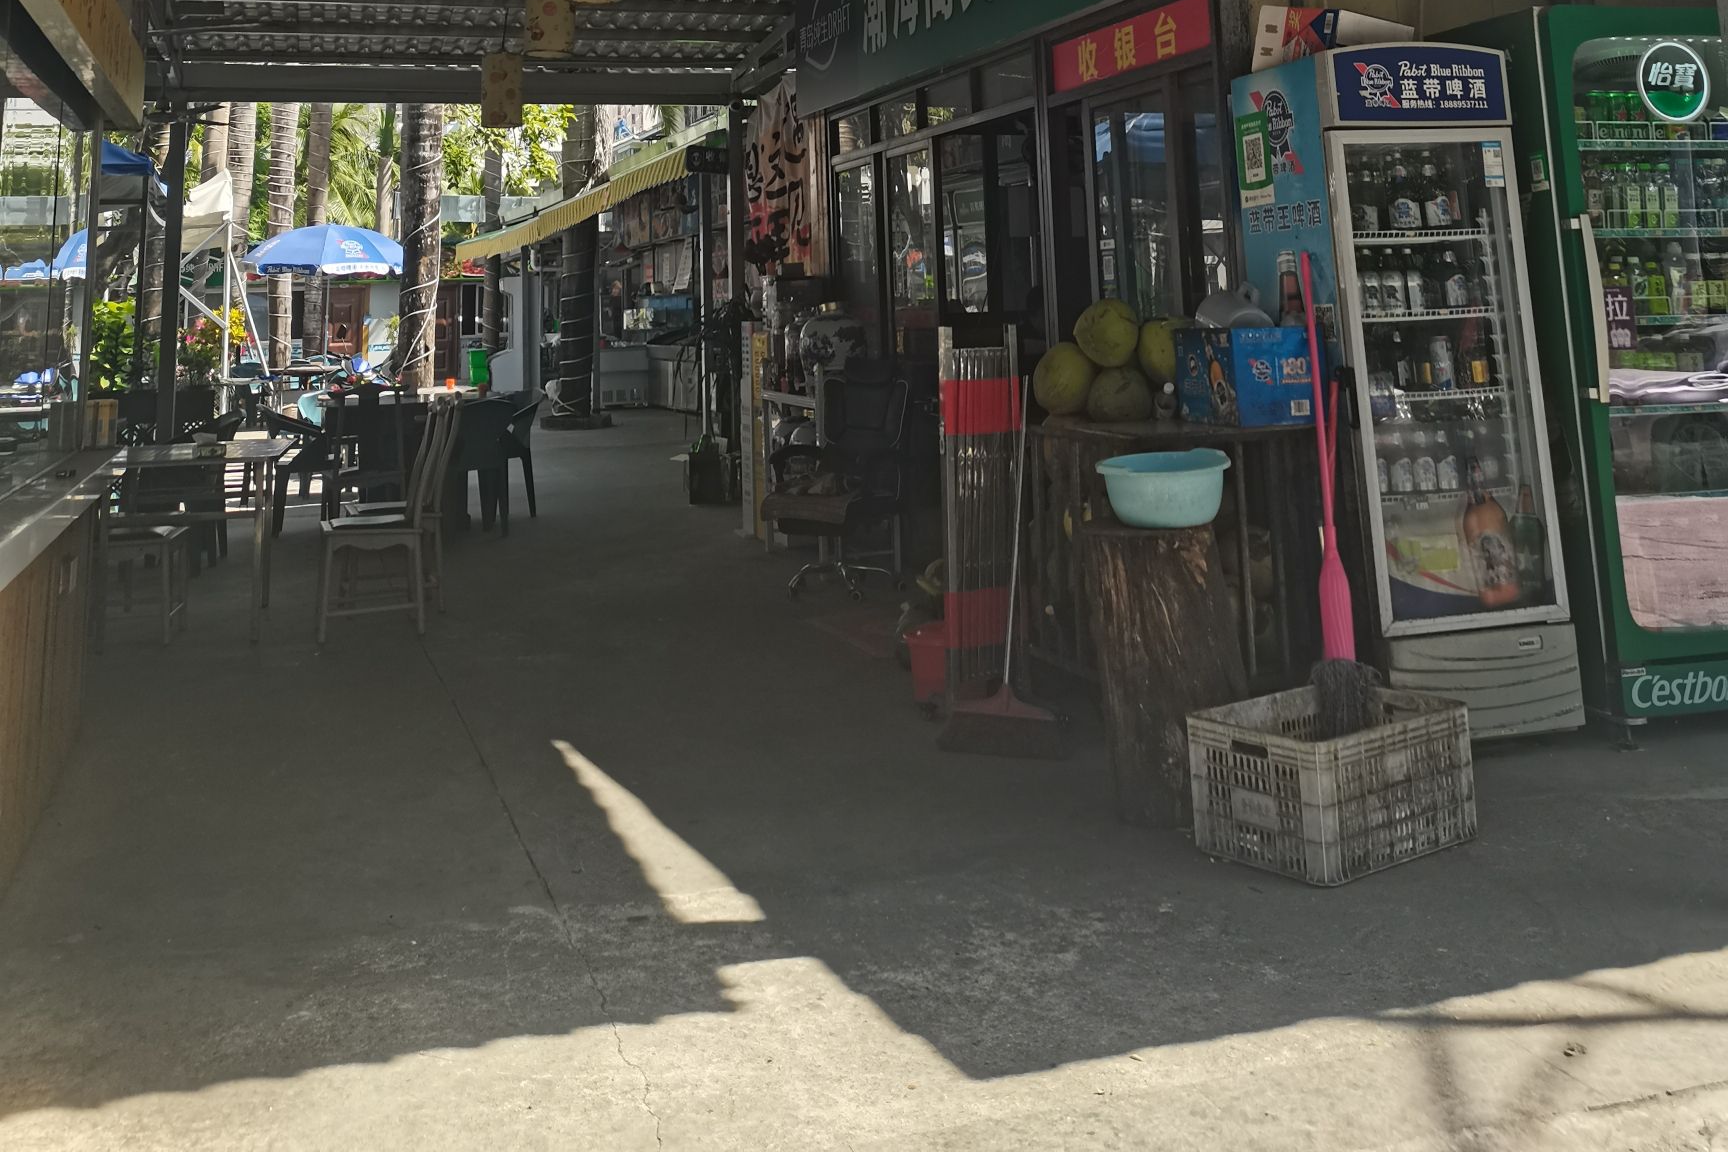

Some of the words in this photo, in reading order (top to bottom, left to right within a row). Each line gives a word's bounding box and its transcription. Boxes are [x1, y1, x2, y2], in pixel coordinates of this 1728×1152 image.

[1078, 11, 1177, 83] 收银台
[1398, 60, 1427, 77] Pabst
[1430, 64, 1451, 77] Blue
[1452, 64, 1485, 77] Ribbon
[1648, 61, 1698, 89] 怡寶
[1400, 78, 1487, 99] 蓝带啤酒
[1265, 100, 1283, 118] Pabst
[1249, 200, 1322, 234] 蓝带王啤酒
[1605, 293, 1631, 322] 拉
[1631, 671, 1728, 709] C'estbo
